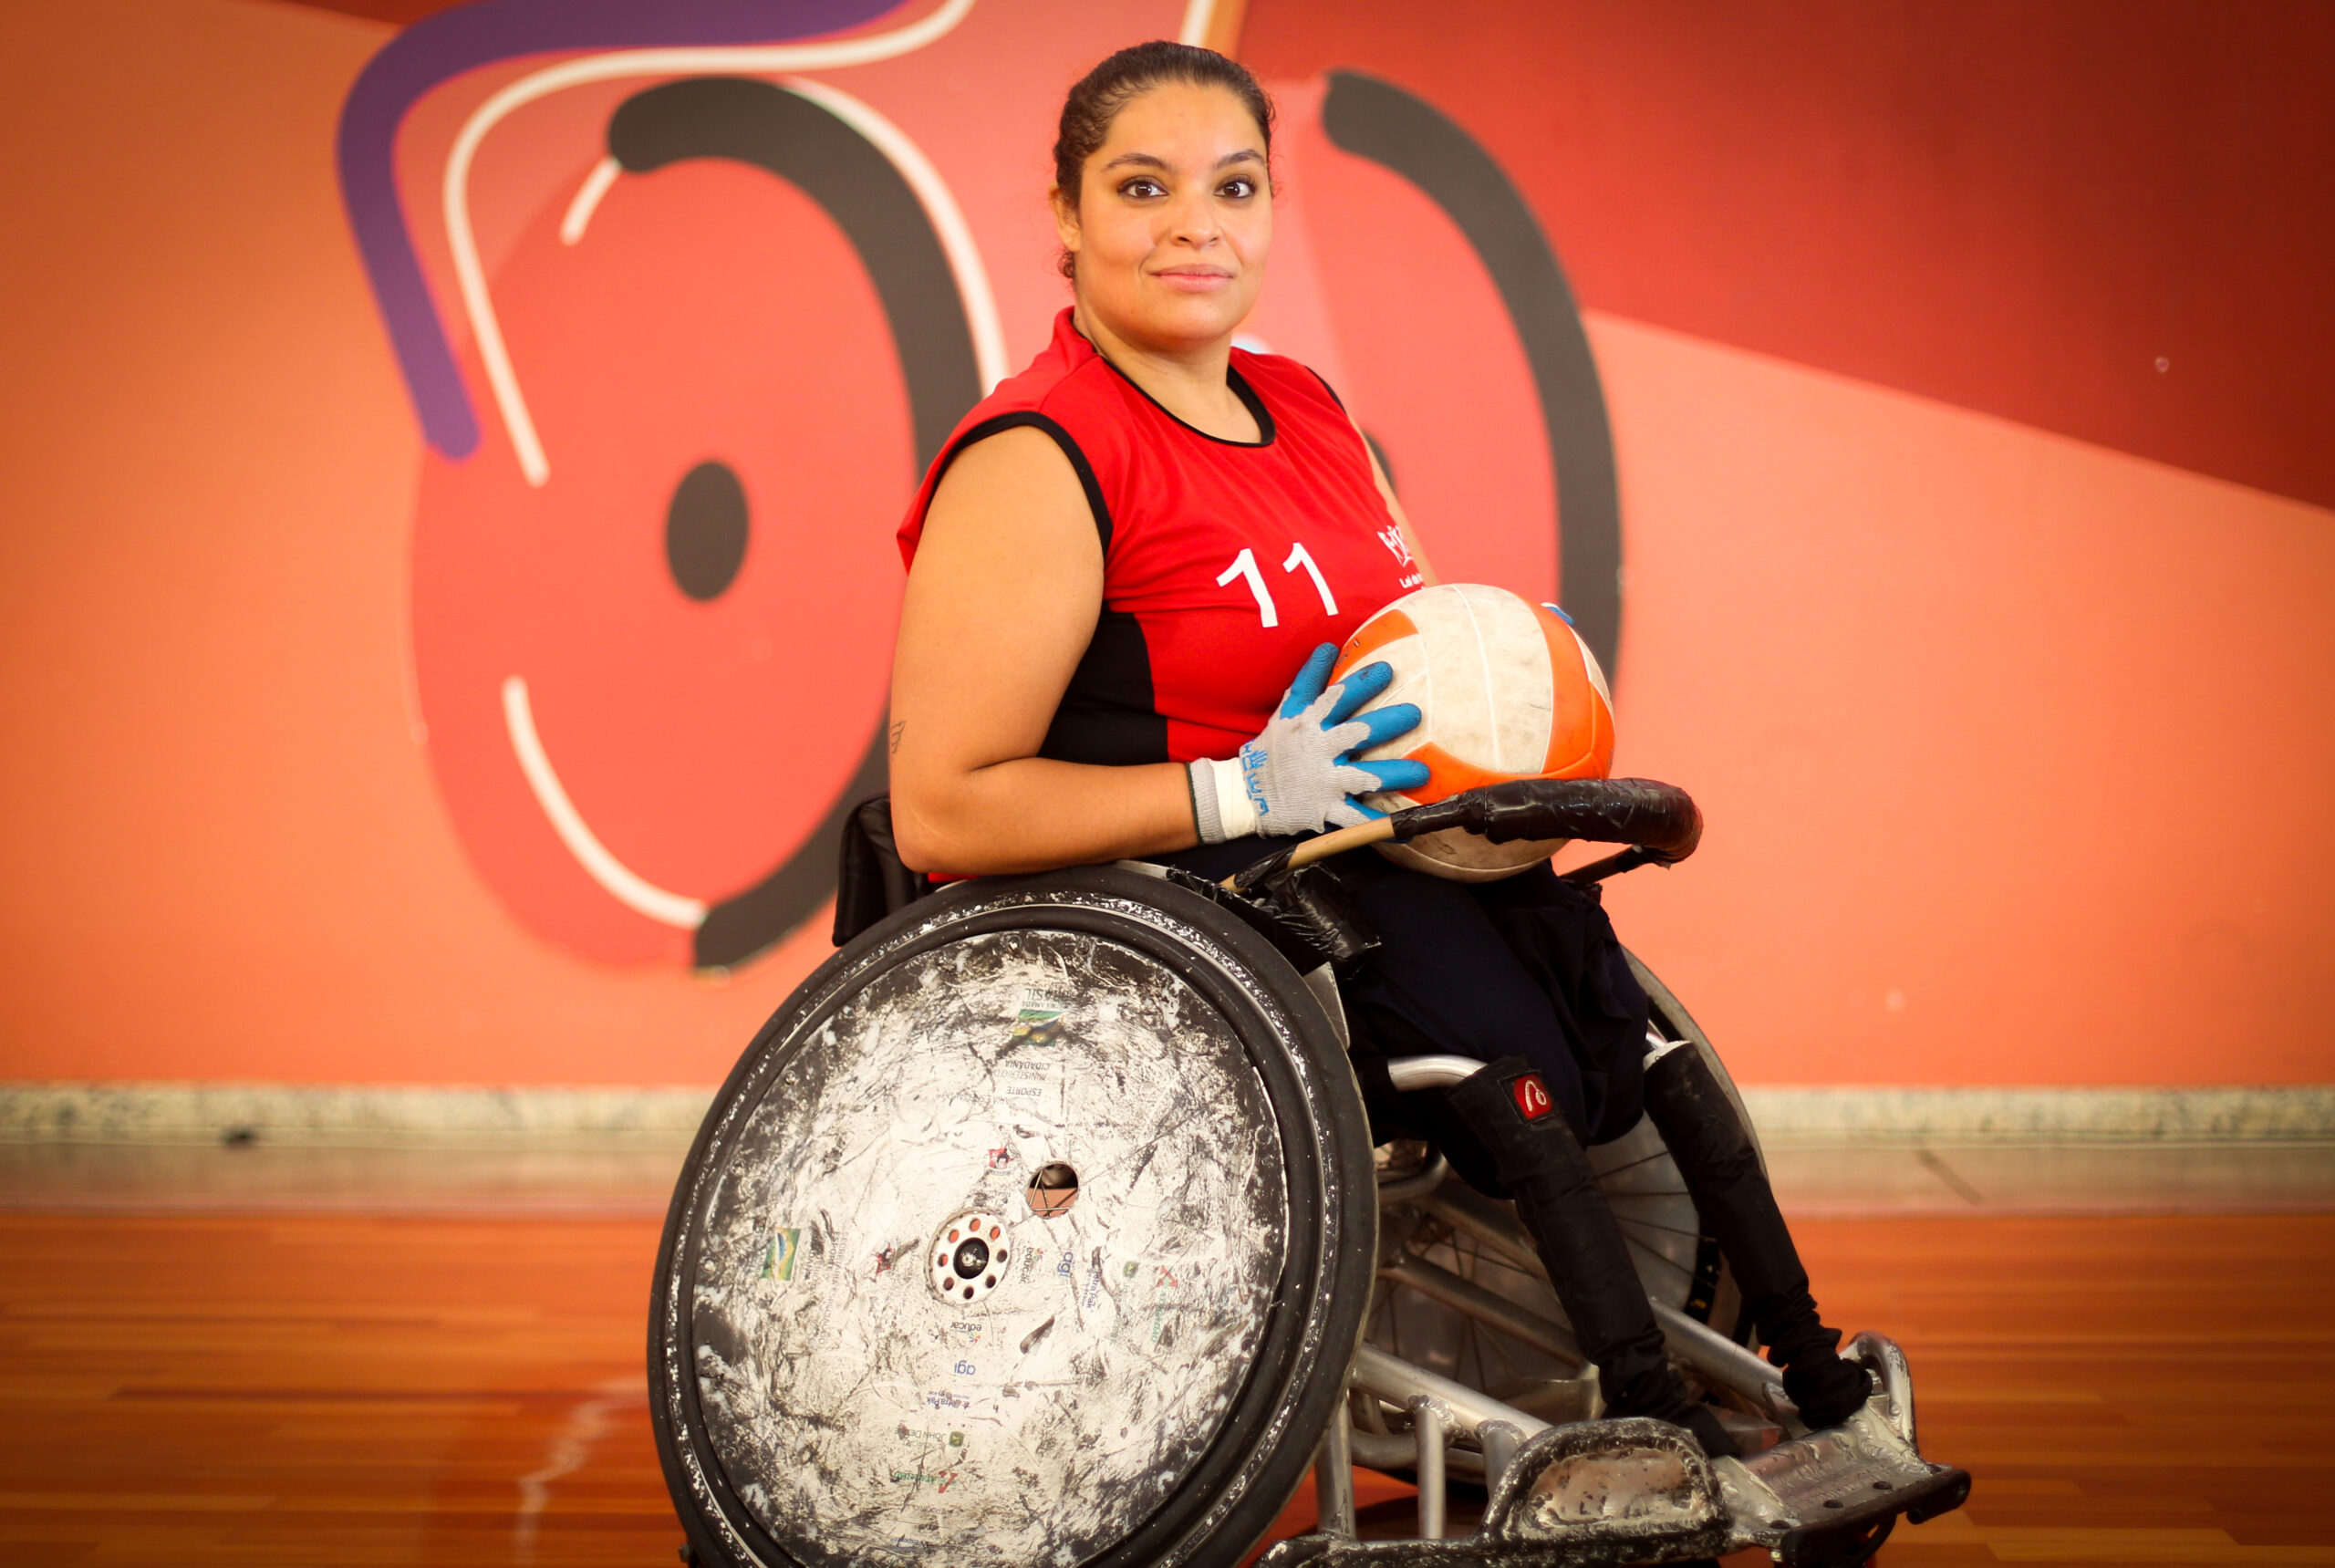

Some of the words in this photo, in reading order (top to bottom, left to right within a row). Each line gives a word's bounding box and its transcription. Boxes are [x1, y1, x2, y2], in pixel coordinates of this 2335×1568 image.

[1216, 542, 1338, 628] 11
[1006, 1086, 1043, 1096] ESPORTE
[1021, 1247, 1034, 1283] educar
[950, 1321, 982, 1335] educar
